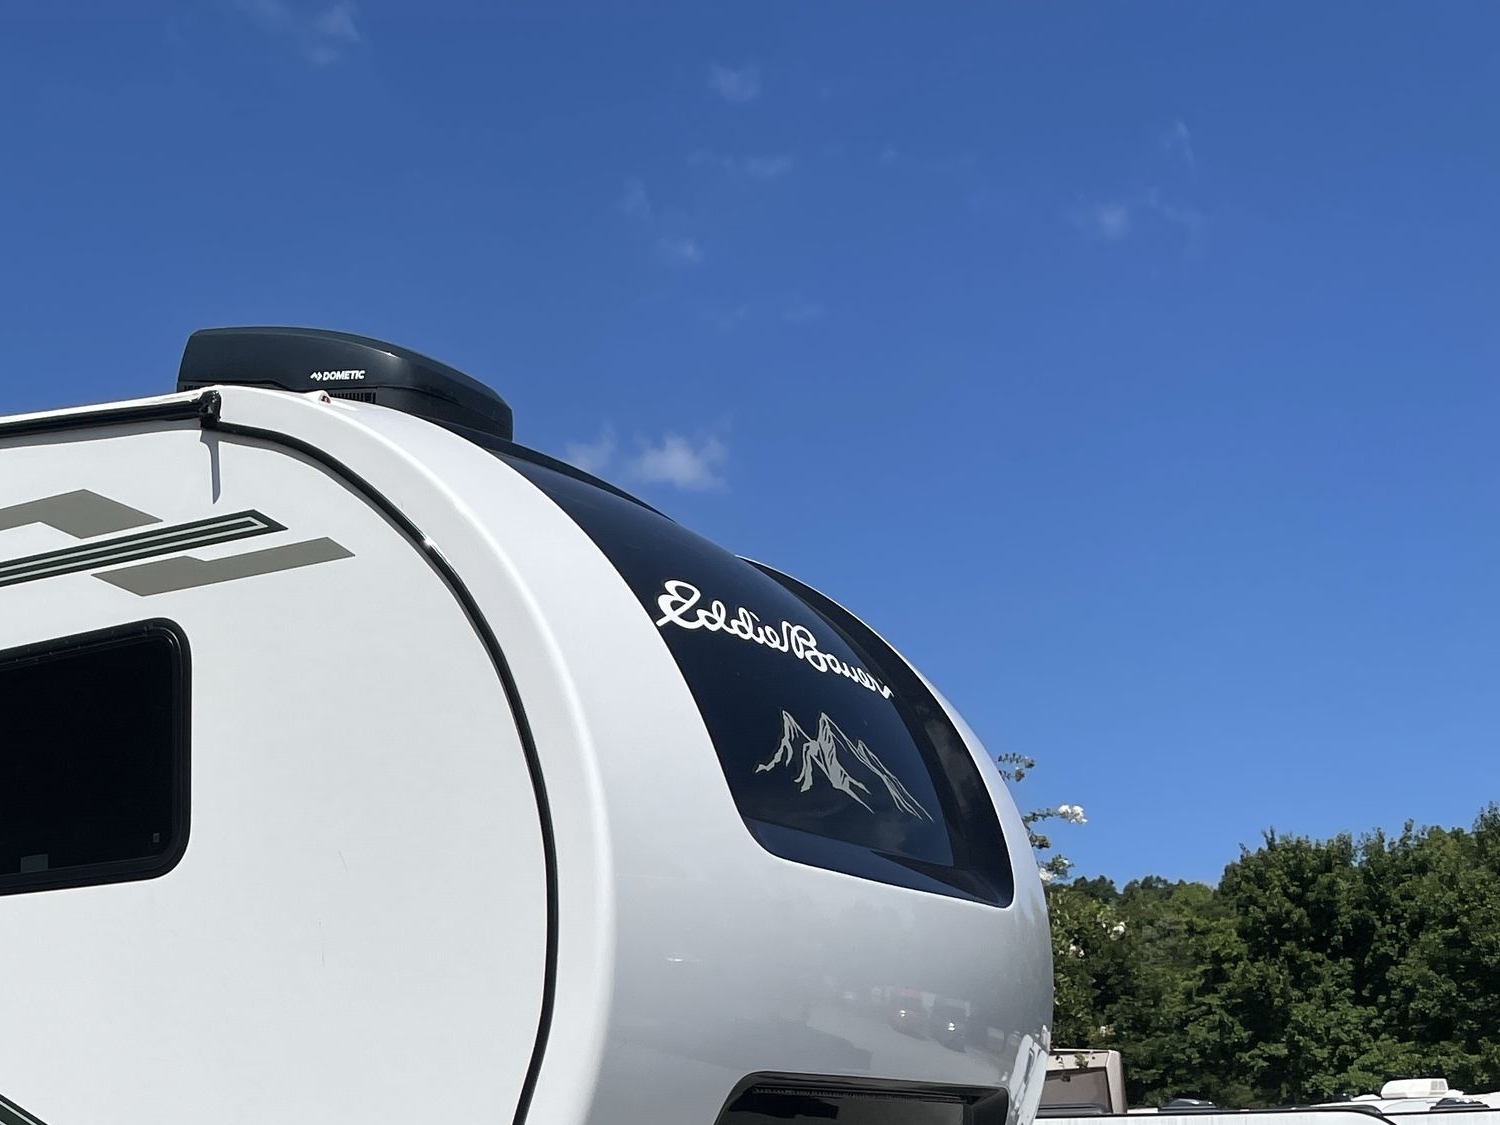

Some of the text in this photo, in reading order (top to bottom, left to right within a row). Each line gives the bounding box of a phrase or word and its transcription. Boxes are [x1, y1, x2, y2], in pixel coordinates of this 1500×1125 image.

[322, 370, 366, 381] DOMETIC
[656, 579, 894, 699] Eddie Bauer
